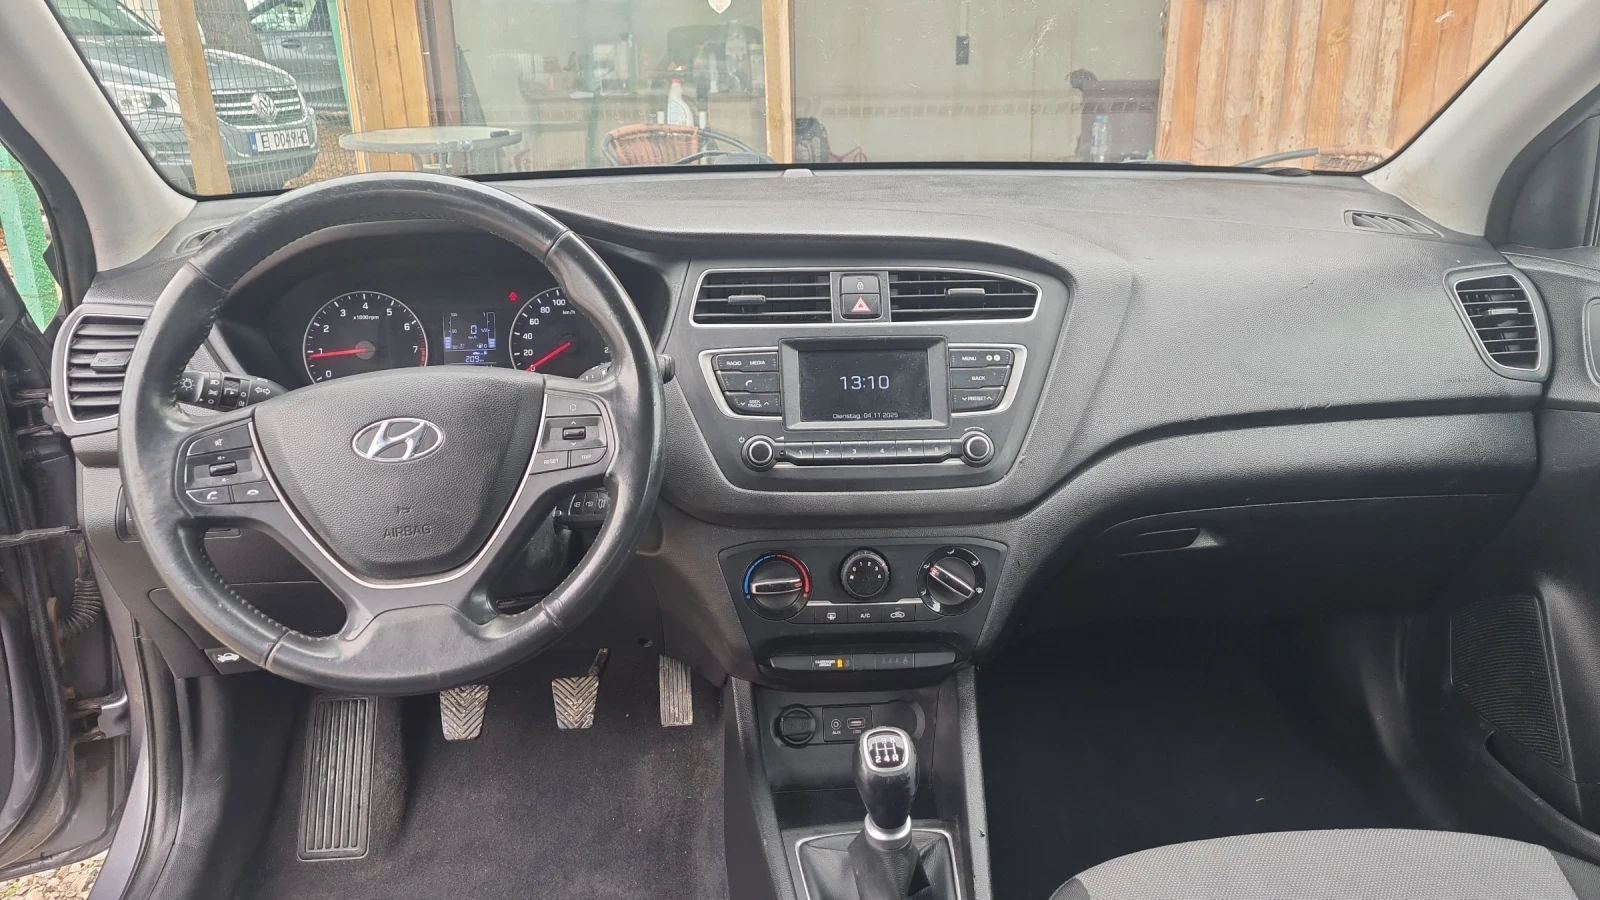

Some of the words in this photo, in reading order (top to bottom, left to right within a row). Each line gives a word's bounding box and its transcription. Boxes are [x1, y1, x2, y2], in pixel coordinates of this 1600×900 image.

[362, 302, 369, 310] 4
[540, 306, 551, 314] 80
[340, 309, 346, 317] 3
[386, 308, 393, 316] 5
[529, 318, 540, 326] 60
[323, 325, 330, 333] 2
[404, 323, 411, 331] 6
[470, 324, 478, 335] 0
[522, 332, 533, 340] 40
[412, 345, 418, 353] 7
[523, 348, 534, 356] 20
[465, 355, 480, 363] 209
[325, 370, 332, 378] 0
[839, 375, 890, 390] 13:10
[384, 523, 432, 539] AIRBAG
[875, 755, 882, 764] 2
[883, 754, 891, 763] 4
[892, 754, 900, 762] R
